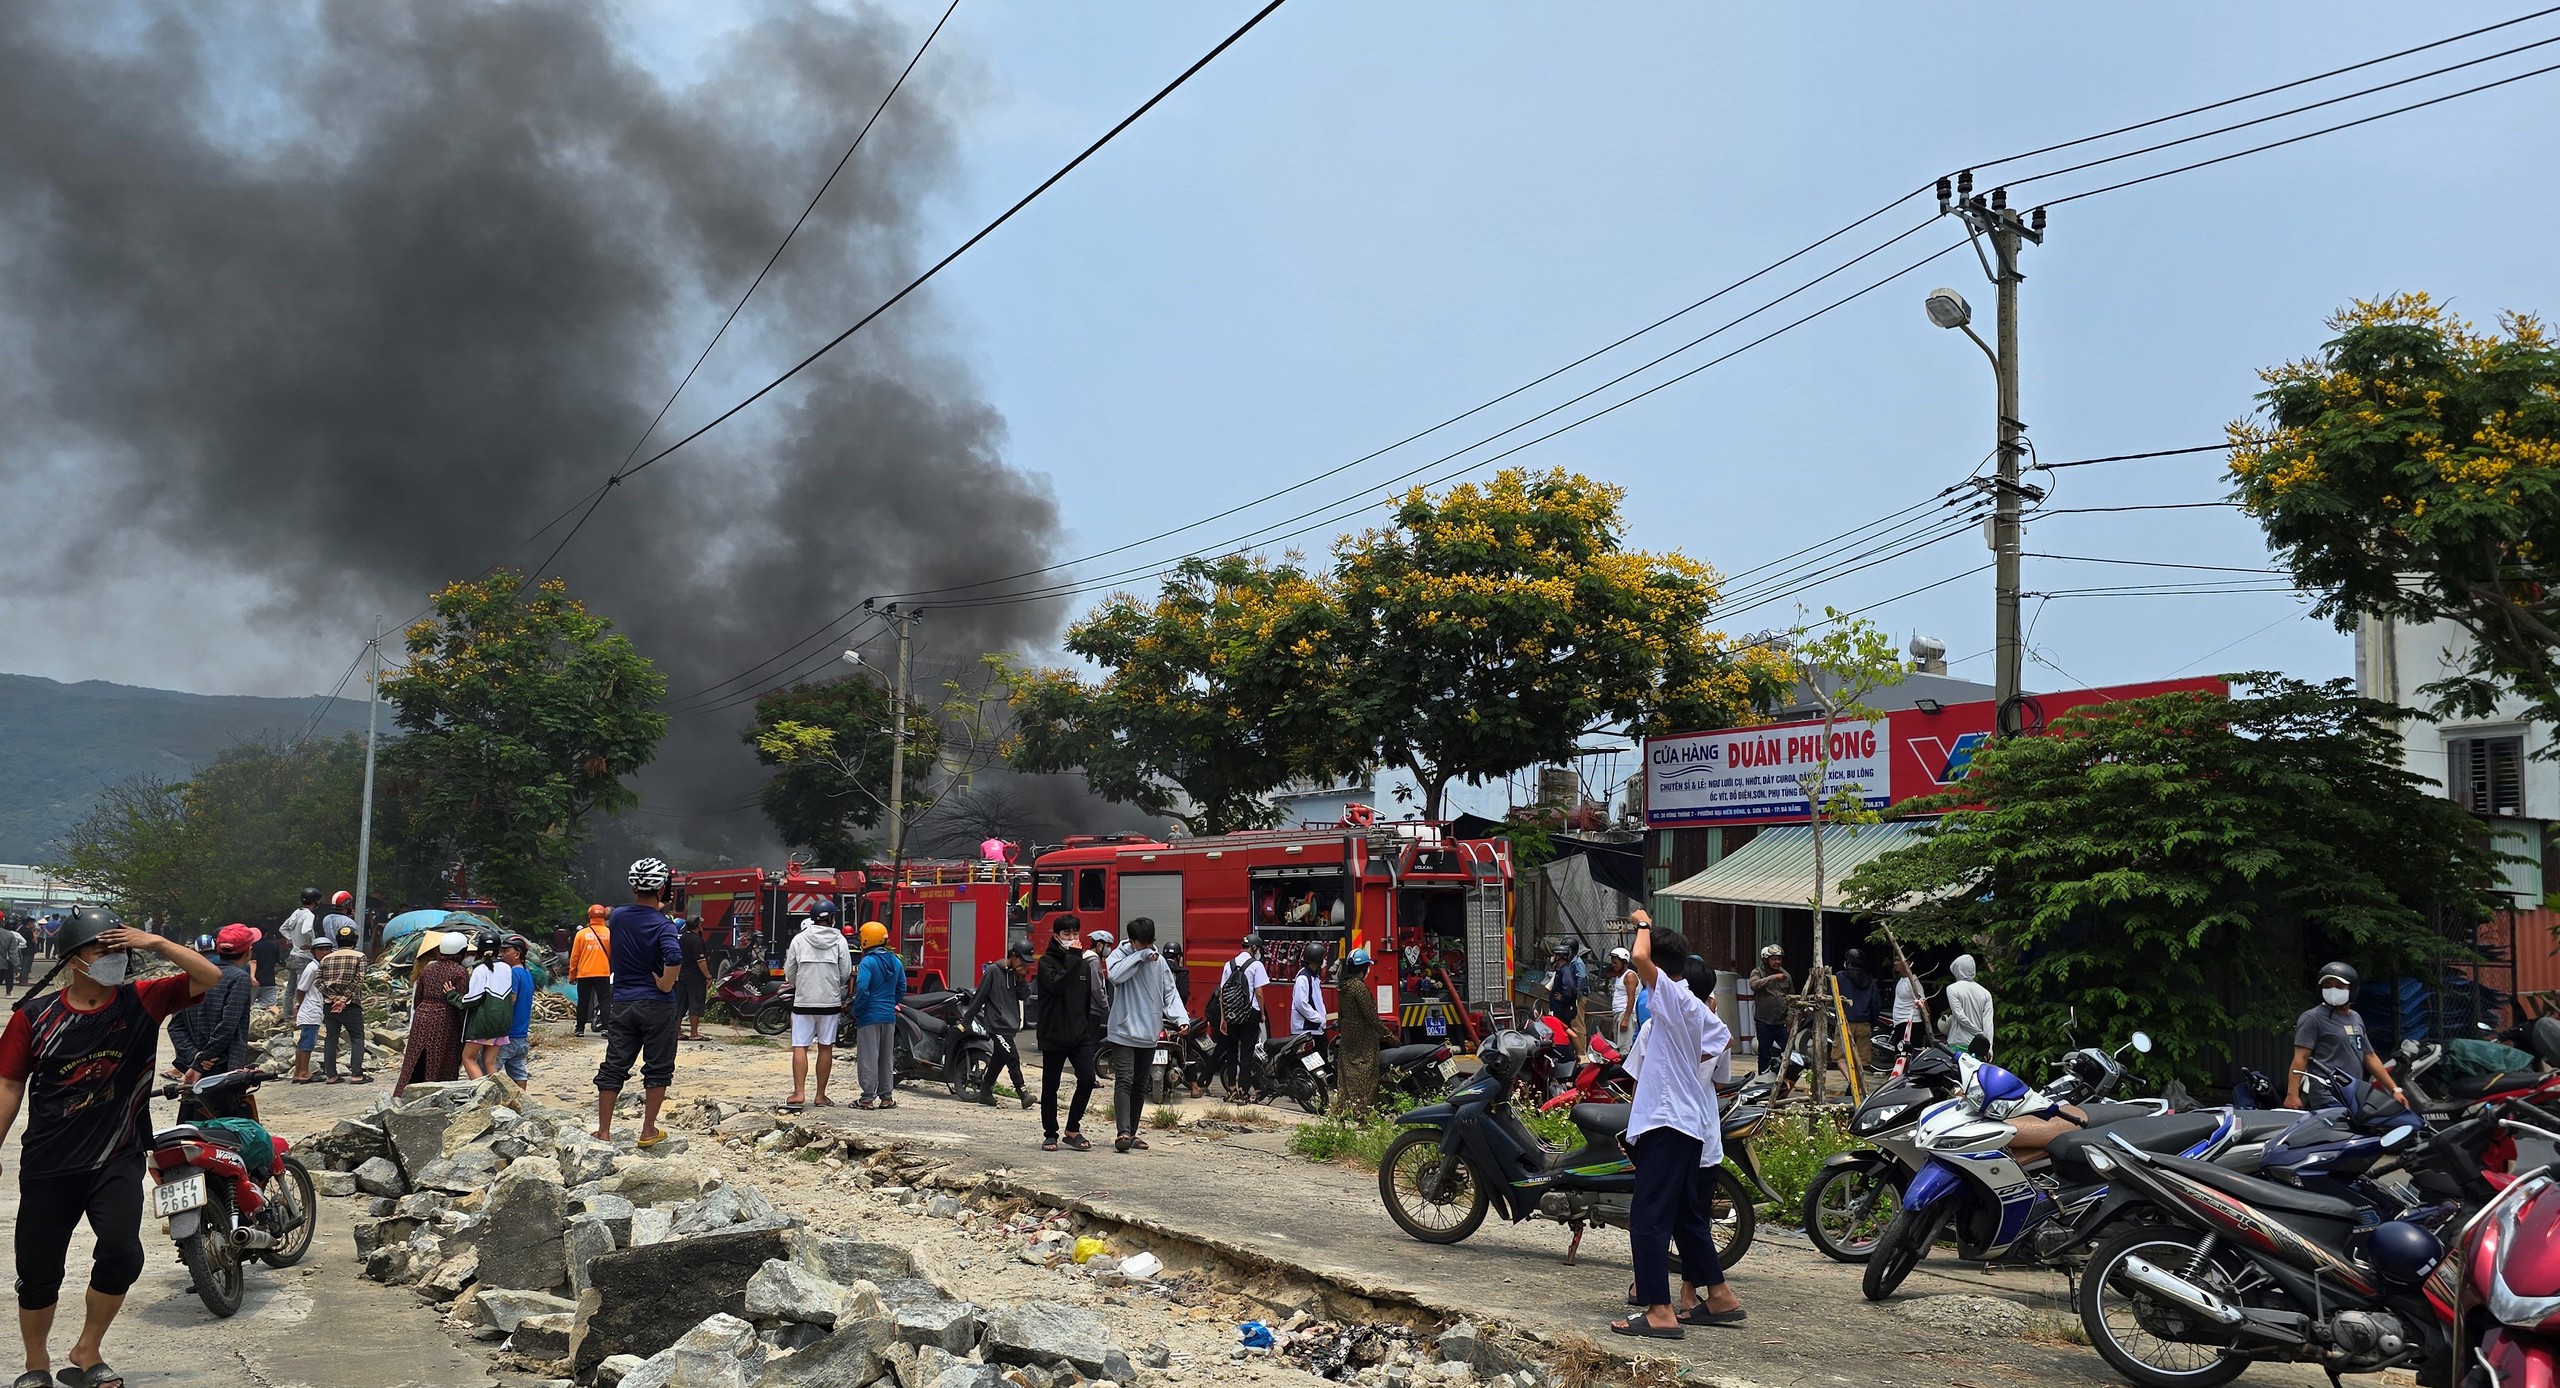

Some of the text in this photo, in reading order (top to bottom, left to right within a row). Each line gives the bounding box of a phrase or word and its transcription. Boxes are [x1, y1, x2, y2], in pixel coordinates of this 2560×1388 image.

[1653, 743, 1718, 764] CỬA HÀNG
[1728, 735, 1781, 768] DUÂN
[1847, 770, 1856, 778] BU
[59, 1056, 87, 1075] STRONG
[2422, 1113, 2450, 1121] YAMAHA
[160, 1179, 197, 1200] 69-F4
[162, 1193, 197, 1215] 2661
